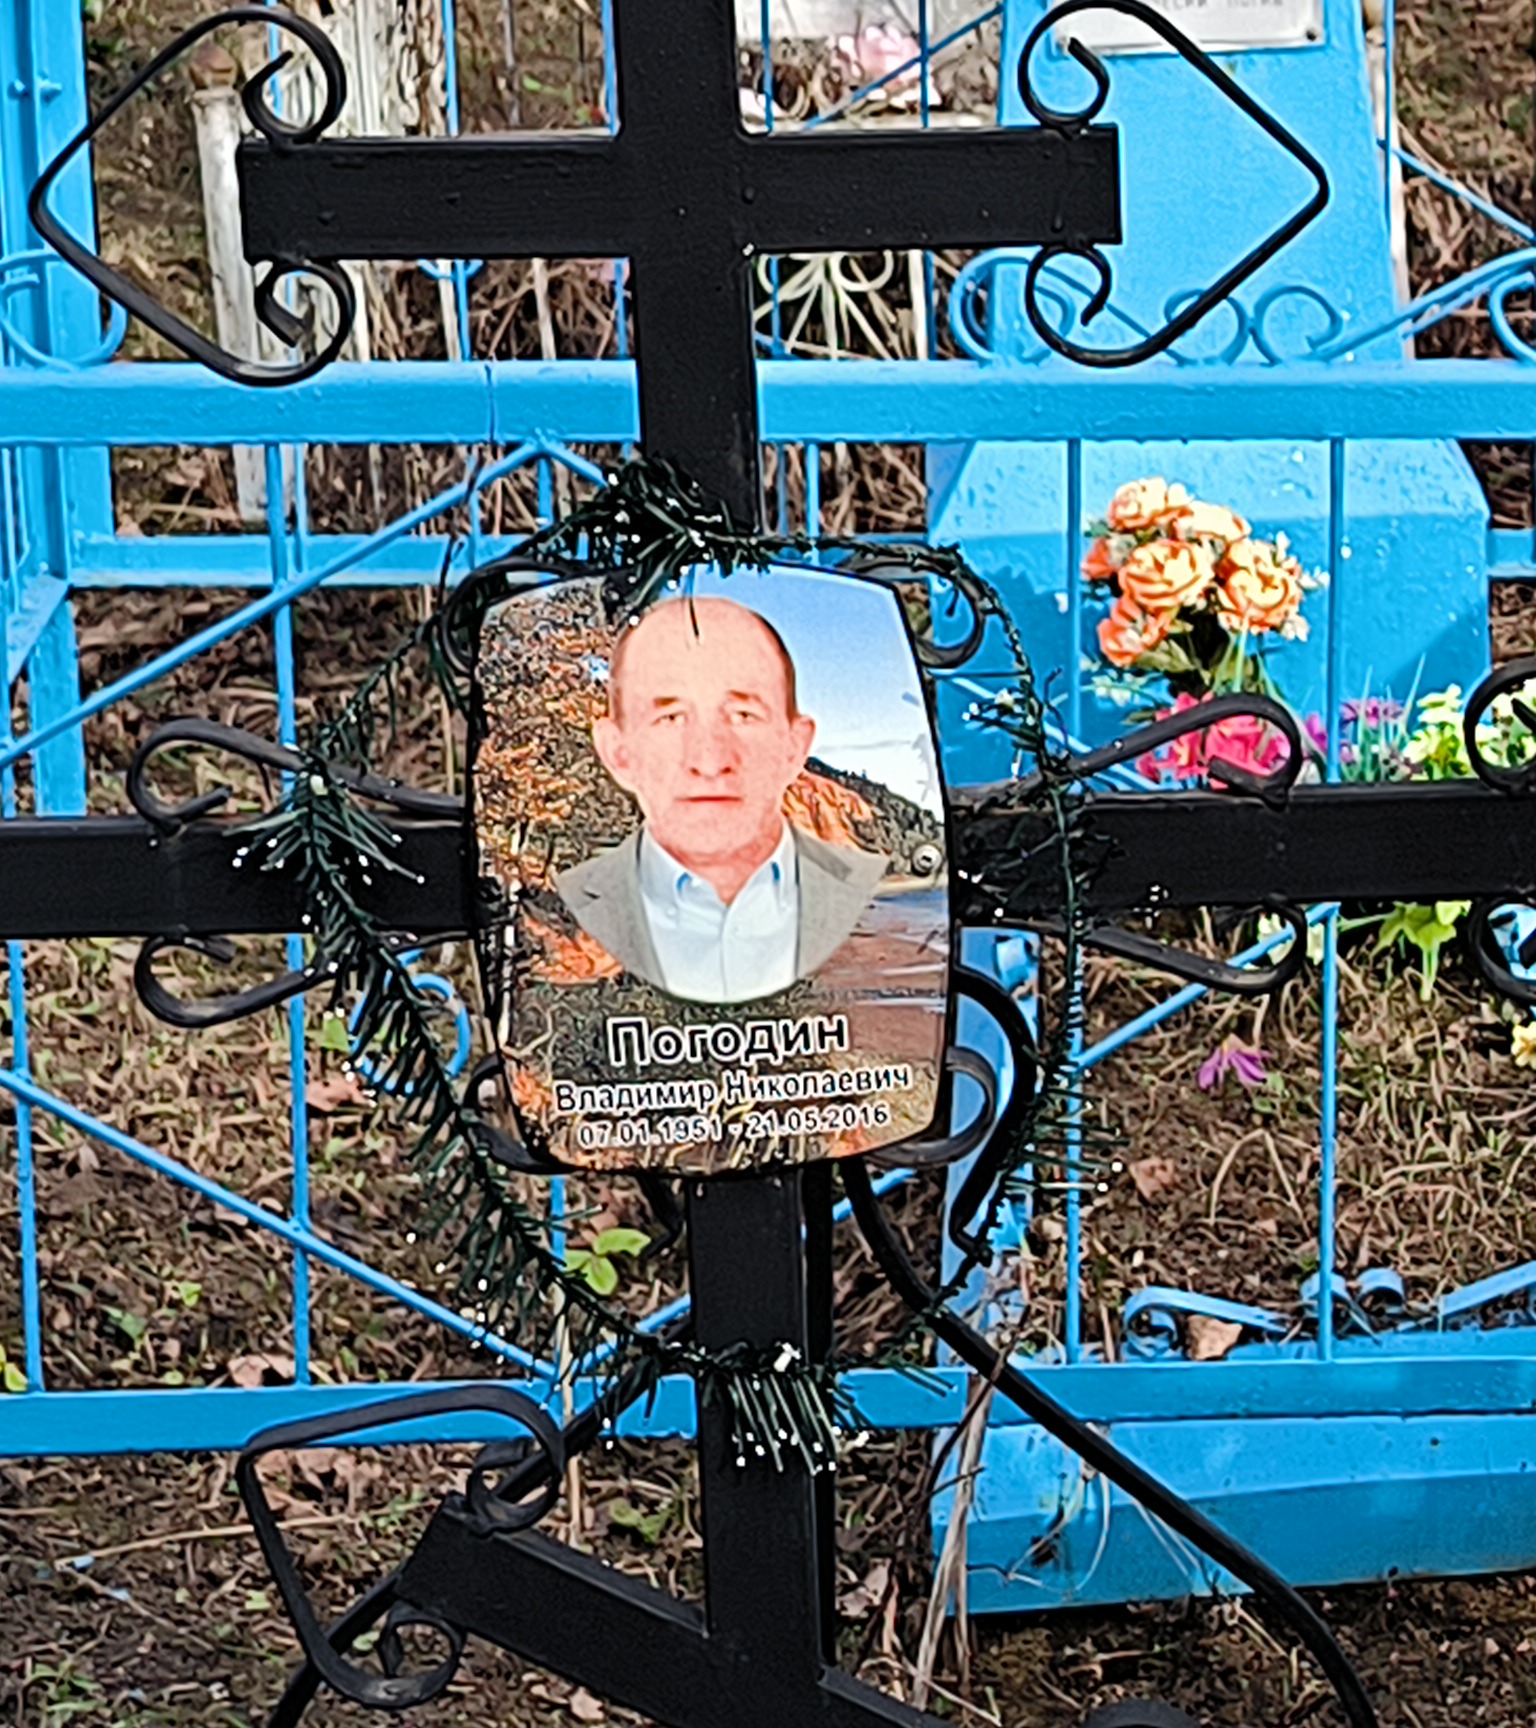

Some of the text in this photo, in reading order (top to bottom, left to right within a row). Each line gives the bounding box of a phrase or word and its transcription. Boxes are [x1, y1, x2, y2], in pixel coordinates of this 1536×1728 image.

[609, 1015, 848, 1066] Погодин
[556, 1064, 911, 1114] Владимир Николаевич
[580, 1117, 722, 1149] 07.01.1951
[747, 1103, 889, 1138] 21.05.2016
